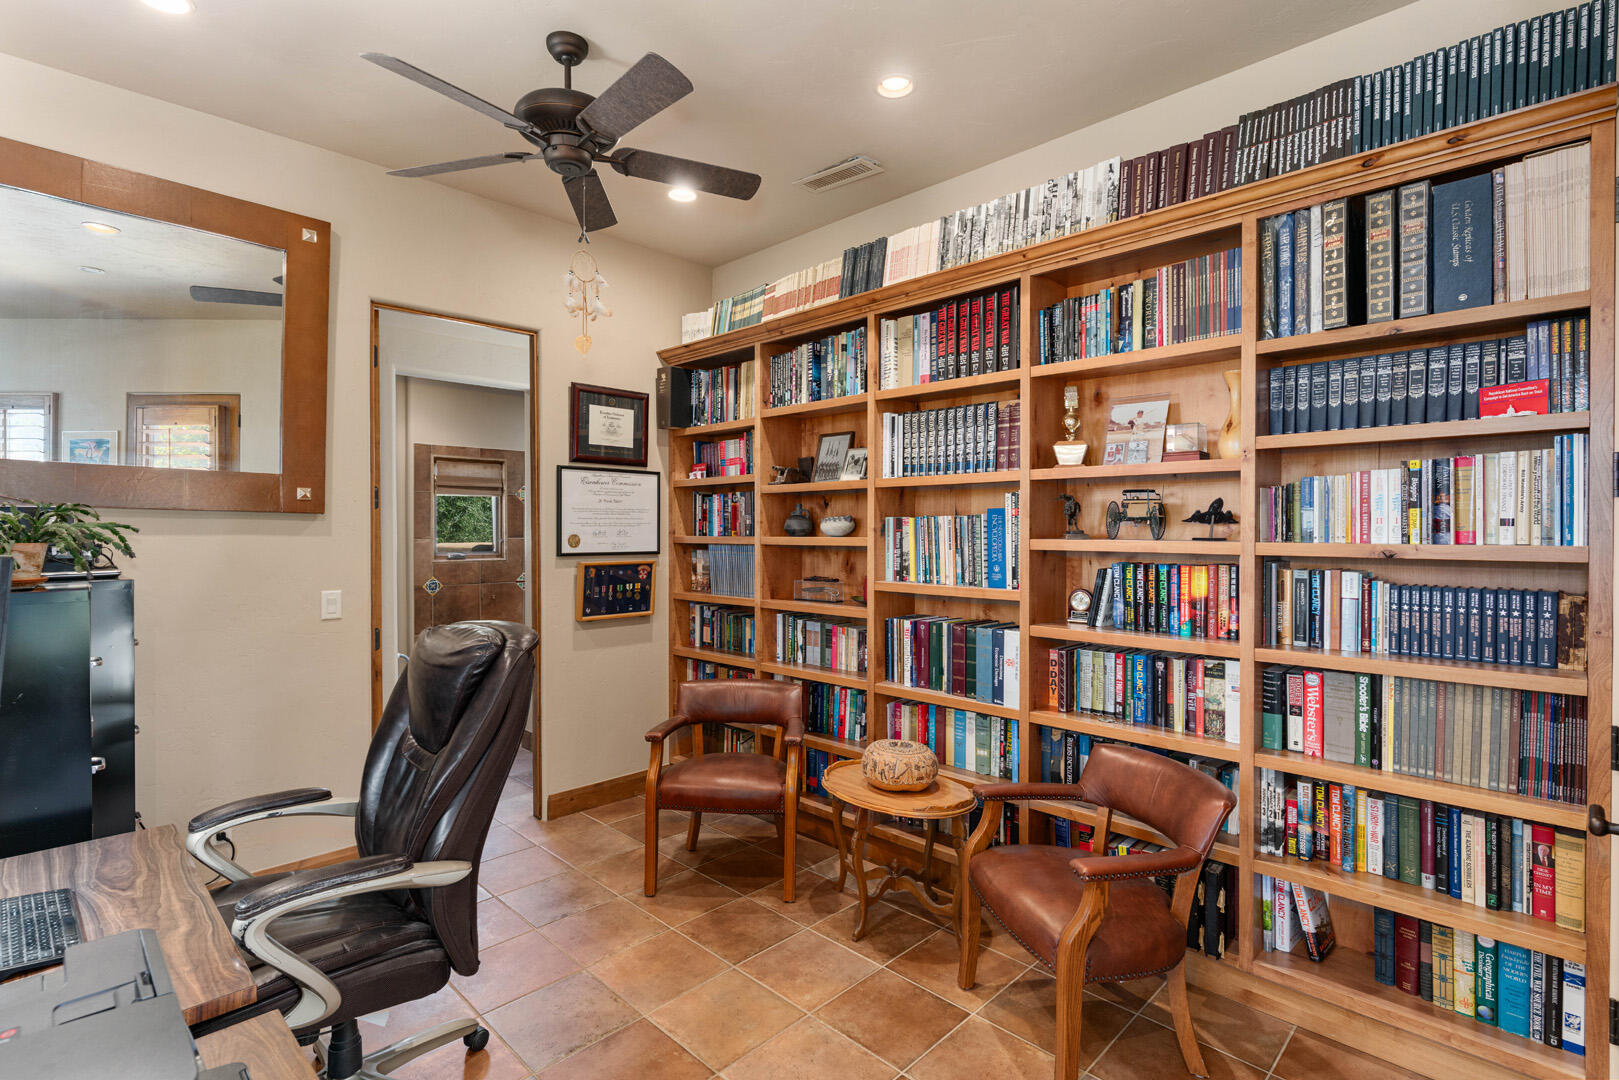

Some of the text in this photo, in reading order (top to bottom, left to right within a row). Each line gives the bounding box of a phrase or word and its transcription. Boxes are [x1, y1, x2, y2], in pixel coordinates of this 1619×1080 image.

[1449, 243, 1462, 267] Stamps
[938, 307, 946, 357] THE GREAT WAR
[960, 302, 968, 354] THE GREAT WAR
[972, 299, 980, 352] THE GREAT WAR
[986, 296, 994, 348] THE GREAT WAR
[1002, 291, 1010, 344] THE GREAT WAR
[1410, 478, 1419, 502] Blogging
[1533, 508, 1541, 525] World
[1312, 574, 1320, 616] TOM CLANCY
[1136, 659, 1144, 694] TOM CLANCY
[1188, 692, 1196, 711] NEVER
[1307, 686, 1320, 742] Webster's
[1359, 676, 1370, 732] Shooter's Bible
[1317, 786, 1325, 828] TOM CLANCY
[1332, 790, 1340, 832] TOM CLANCY
[1370, 805, 1379, 826] STORM
[1278, 880, 1286, 920] TOM CLANCY
[1536, 888, 1552, 896] TIME
[1483, 954, 1495, 1000] Geographical
[1533, 952, 1543, 1031] THE CIVIL WAR SOURCE BOOK
